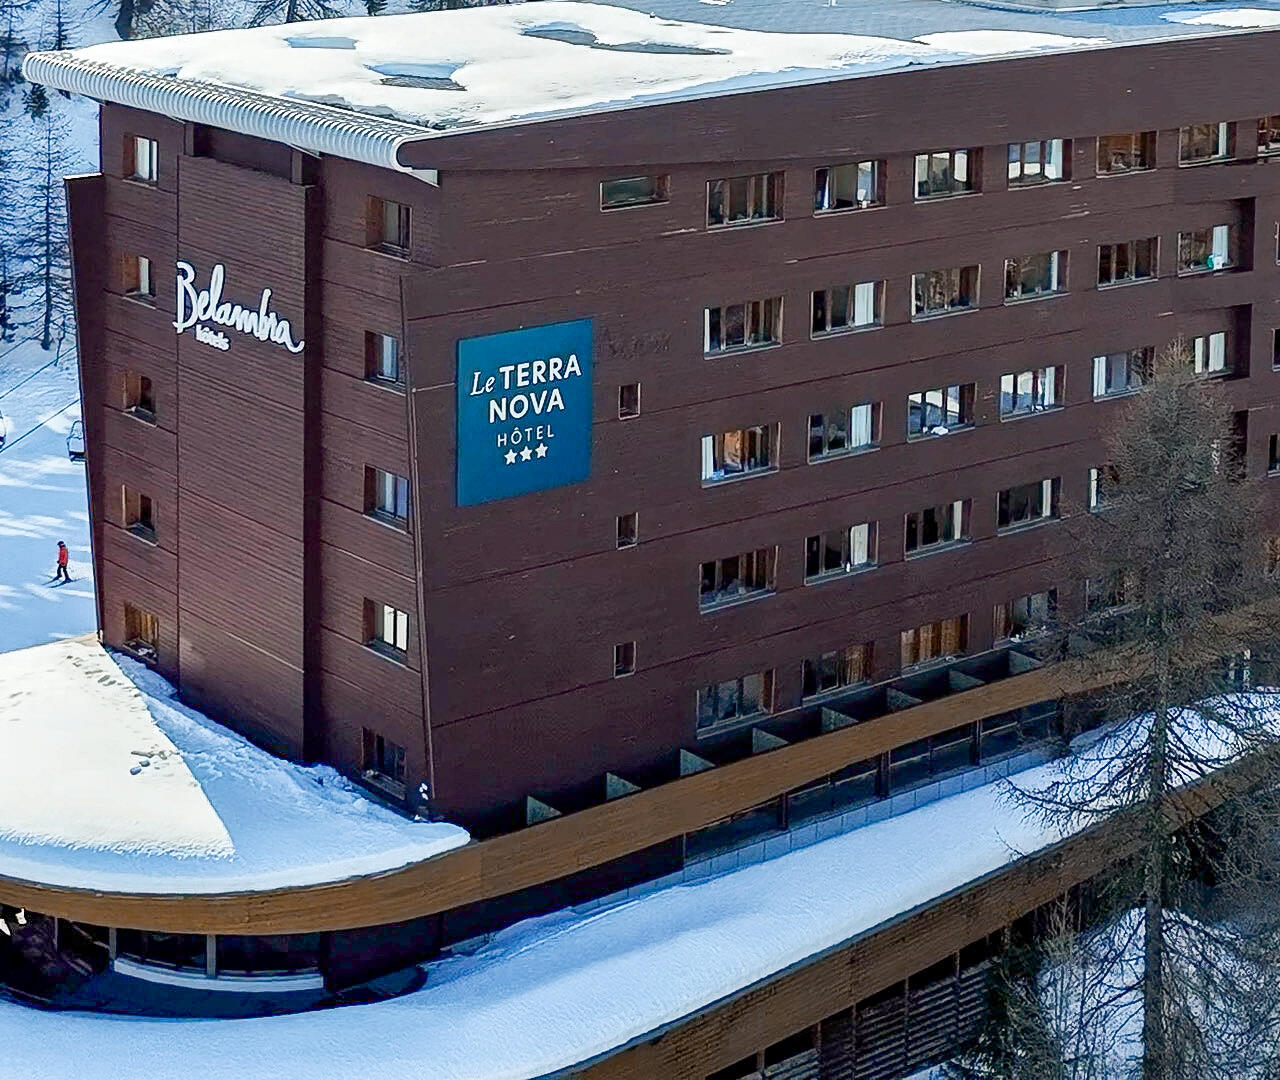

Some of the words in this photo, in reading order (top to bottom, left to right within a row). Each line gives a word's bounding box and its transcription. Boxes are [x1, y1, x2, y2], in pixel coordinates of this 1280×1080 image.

[172, 261, 305, 353] Belambra
[470, 371, 496, 396] Le
[499, 354, 582, 390] TERRA
[489, 388, 565, 424] NOVA
[497, 426, 555, 448] HÔTEL
